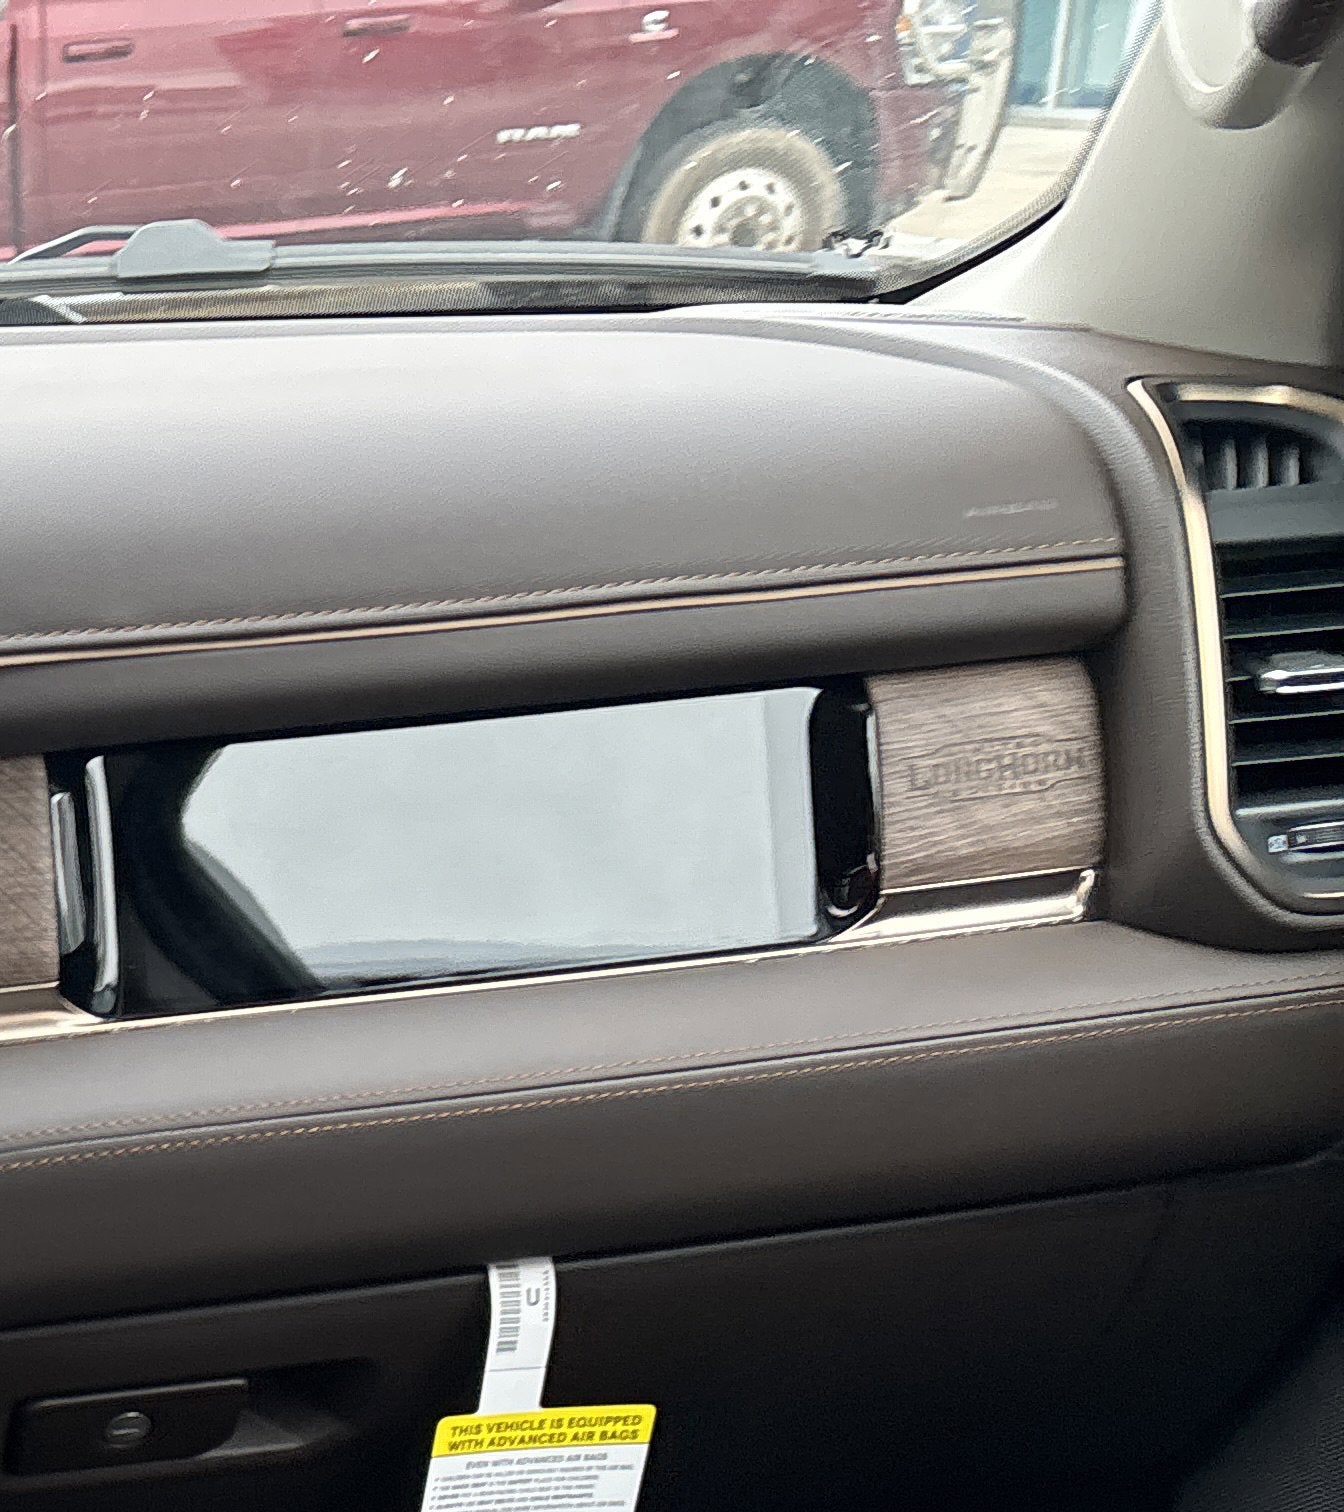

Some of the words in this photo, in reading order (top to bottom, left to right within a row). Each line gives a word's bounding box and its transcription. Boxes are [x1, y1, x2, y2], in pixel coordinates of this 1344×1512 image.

[909, 748, 1087, 793] LONGHORN
[451, 1424, 483, 1438] THIS
[486, 1418, 547, 1434] VEHICLE
[550, 1417, 564, 1429] IS
[568, 1415, 643, 1429] EQUIPPED
[448, 1438, 484, 1452] WITH
[487, 1433, 567, 1449] ADVANCED
[572, 1430, 595, 1442] AIR
[599, 1429, 641, 1441] BAGS
